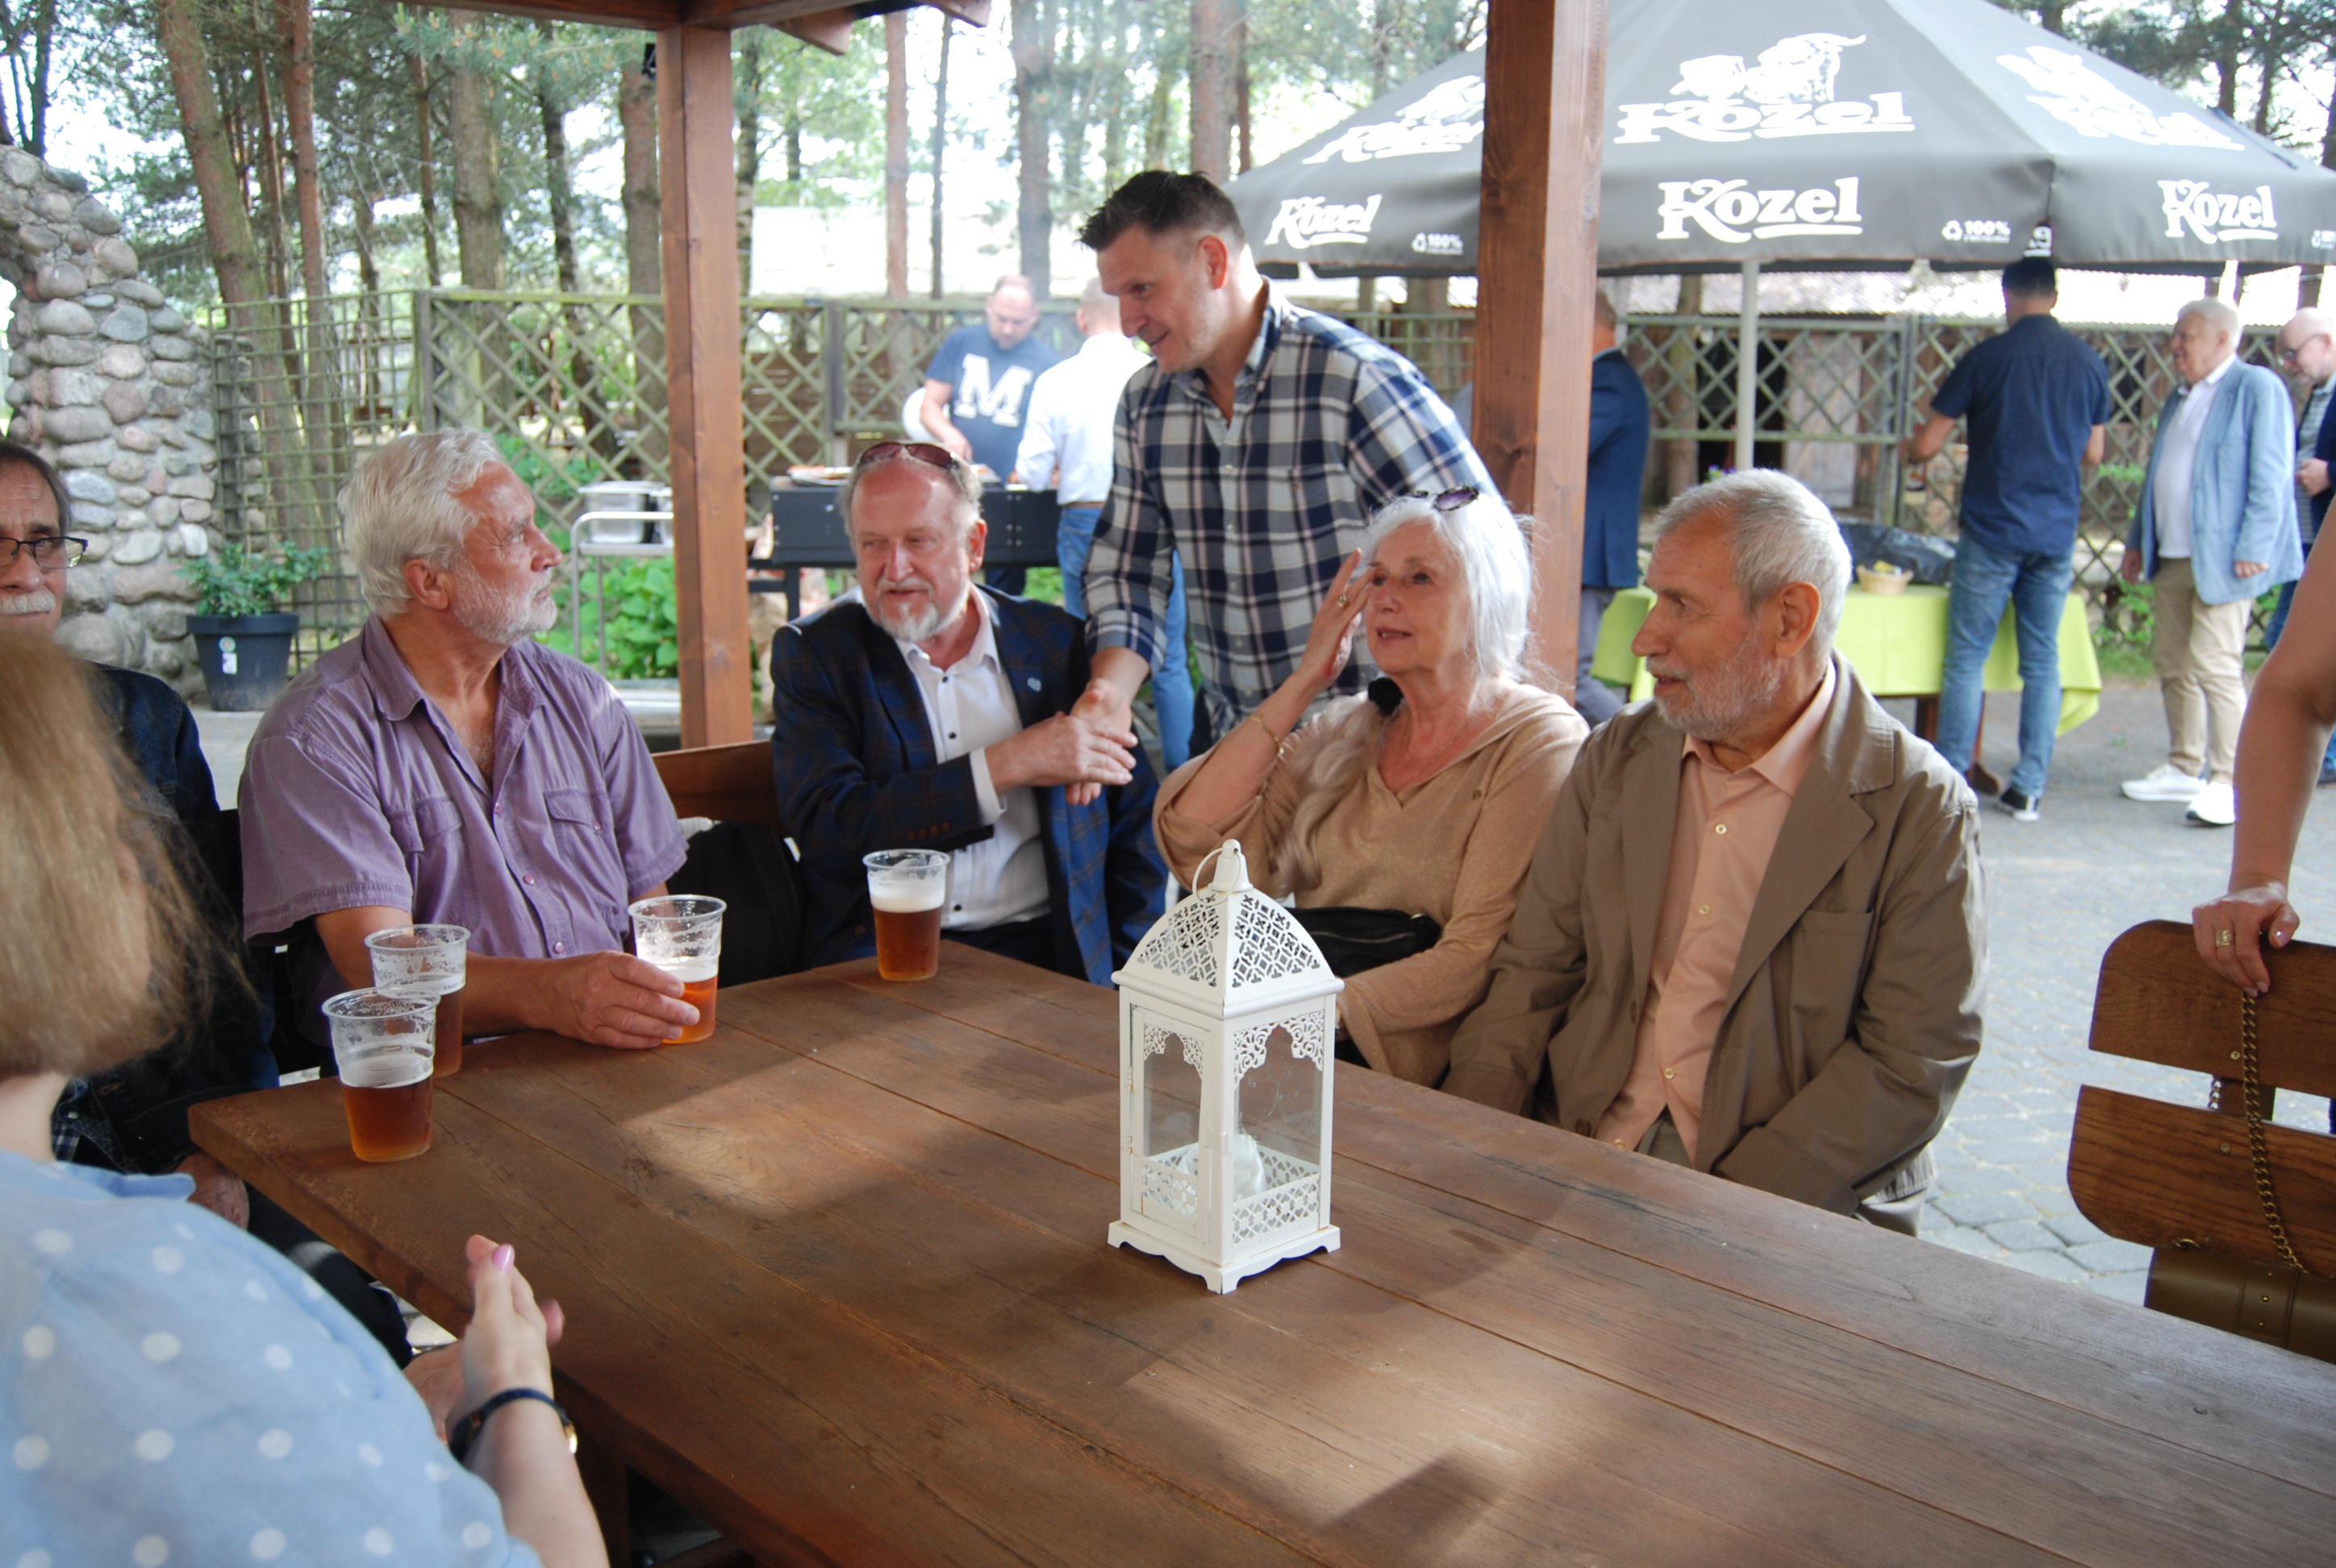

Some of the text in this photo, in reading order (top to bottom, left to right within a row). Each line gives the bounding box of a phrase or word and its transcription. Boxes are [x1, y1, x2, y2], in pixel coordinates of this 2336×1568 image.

[1614, 91, 1915, 144] Kozel
[1264, 194, 1382, 249] Kozel
[1656, 177, 1863, 244] Kozel
[1964, 220, 2011, 236] 100%
[2157, 179, 2278, 244] Kozel
[953, 353, 1033, 427] M
